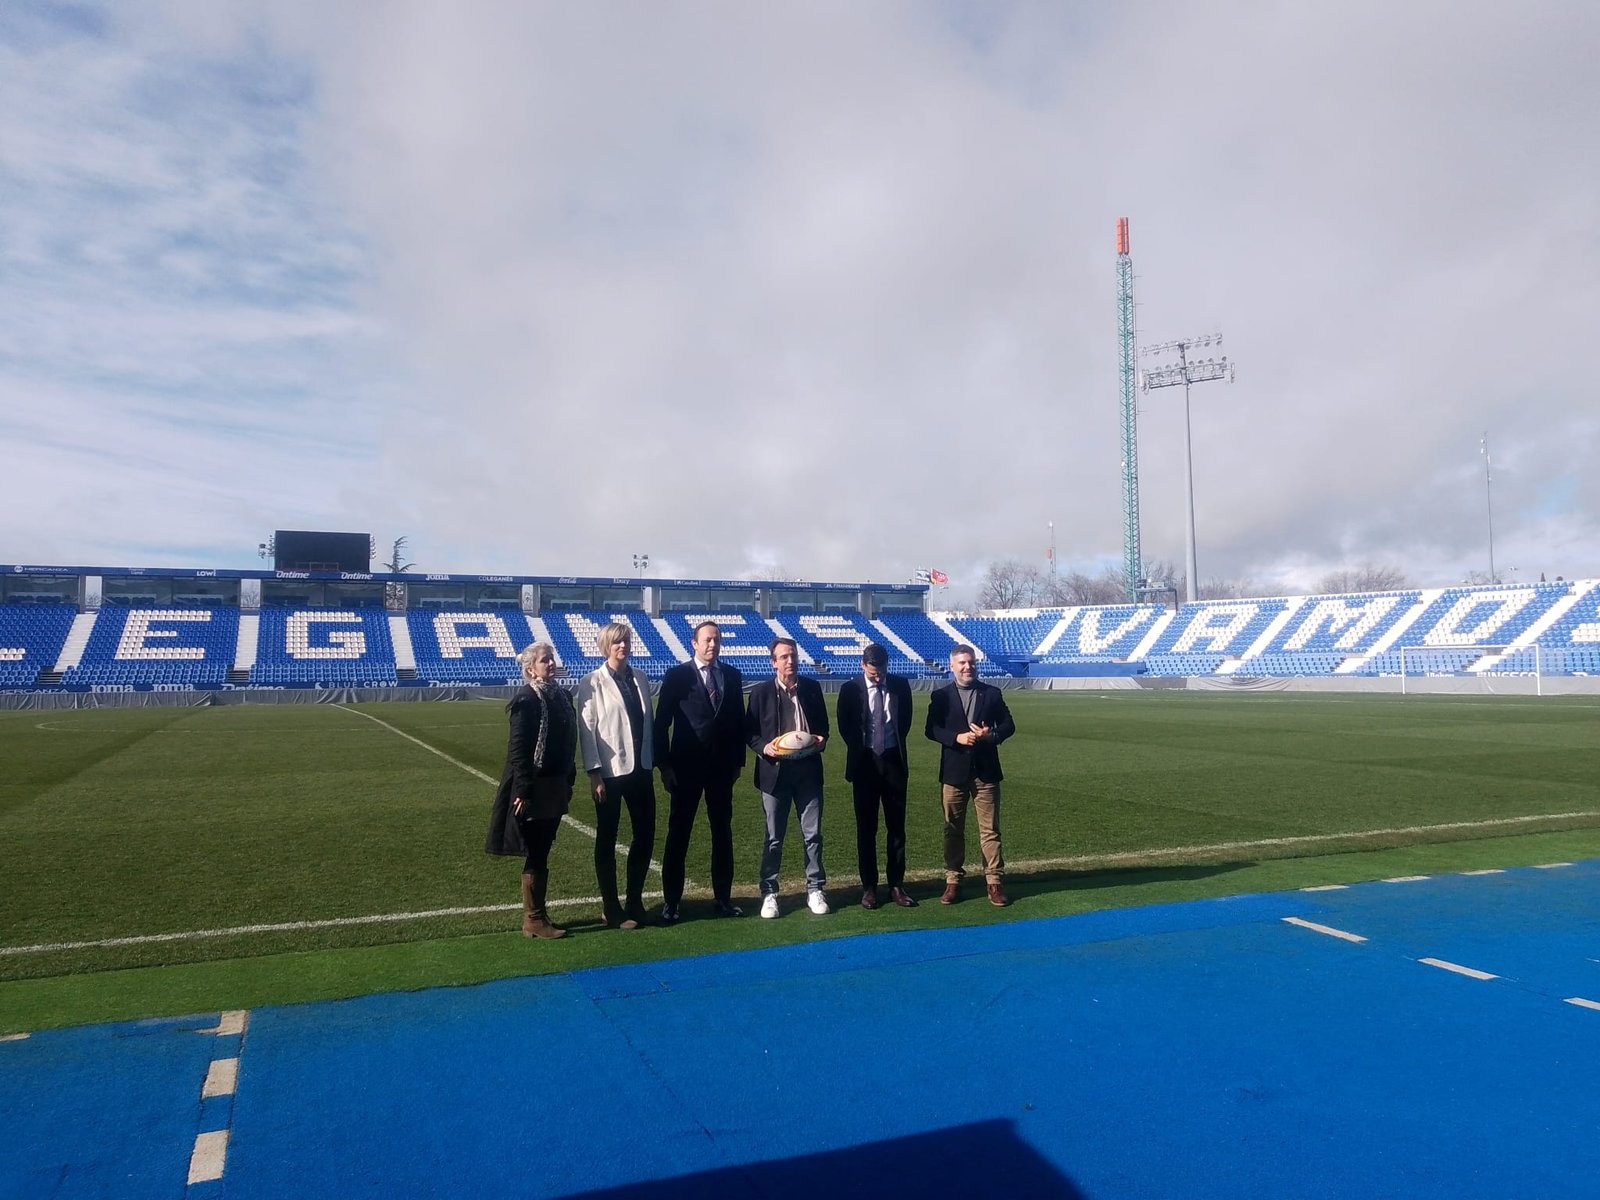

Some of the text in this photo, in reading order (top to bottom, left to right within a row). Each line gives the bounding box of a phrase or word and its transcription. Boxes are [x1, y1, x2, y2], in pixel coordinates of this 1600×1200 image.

[276, 570, 310, 579] Ontime
[340, 571, 373, 580] Ontime
[1076, 591, 1600, 655] VAMO
